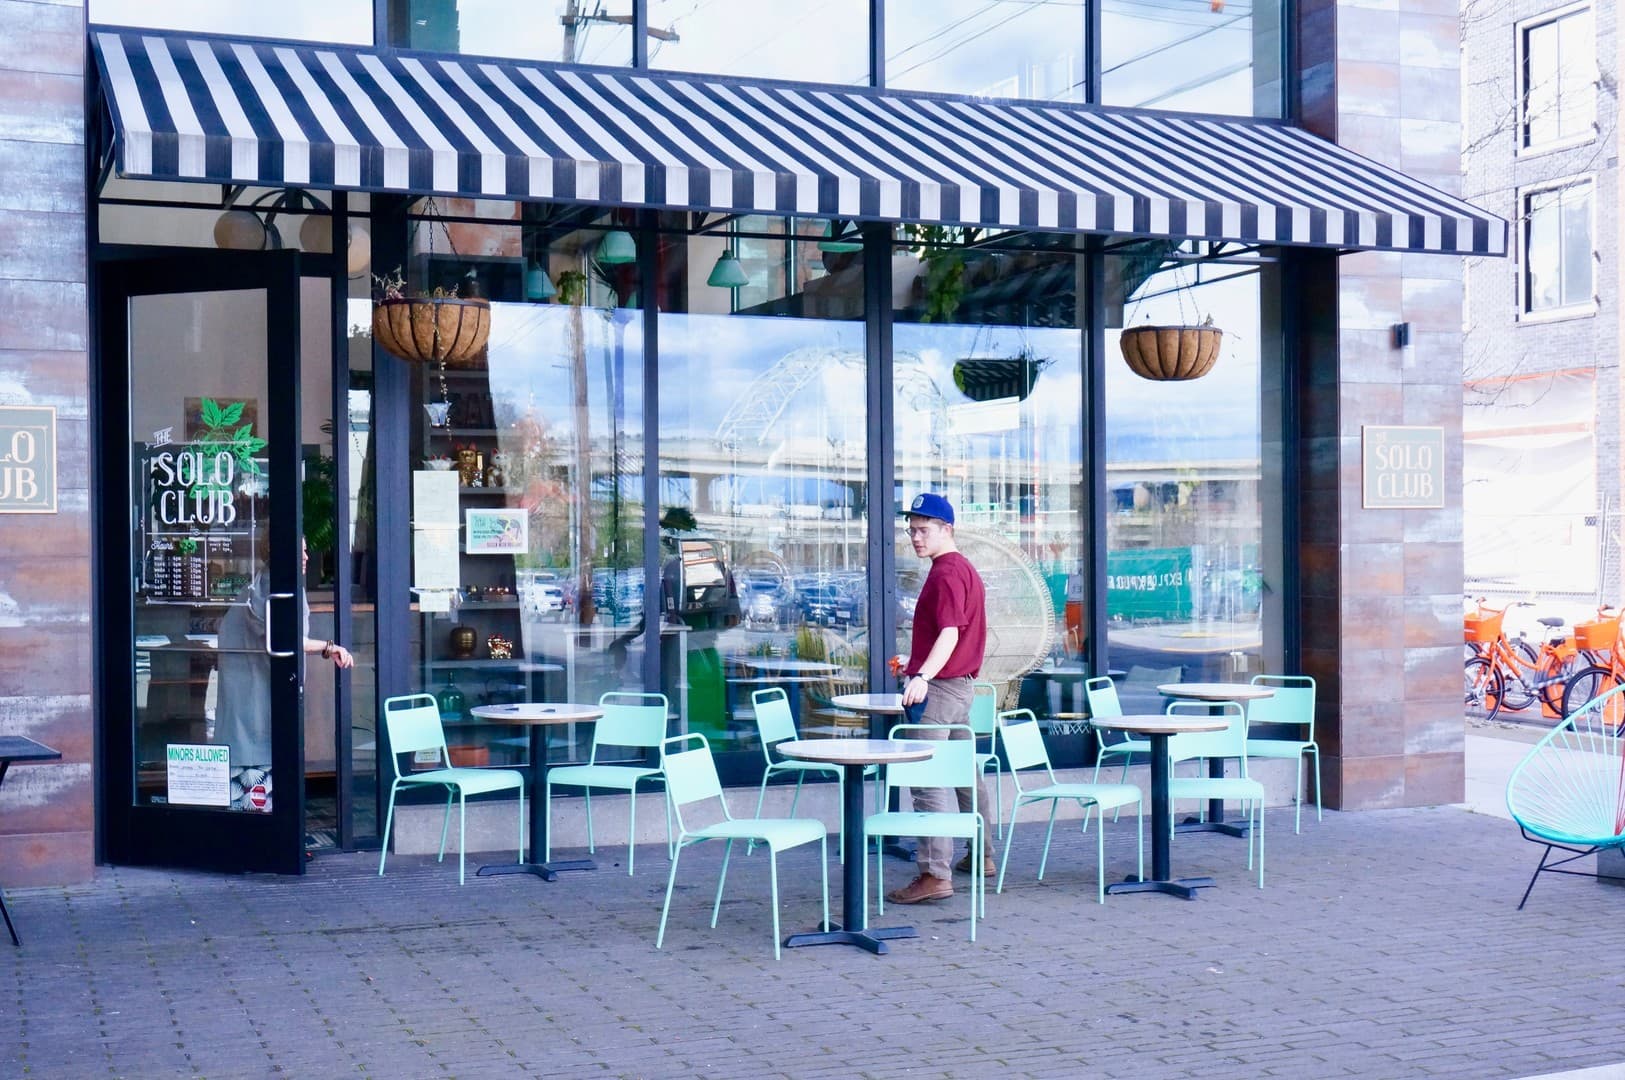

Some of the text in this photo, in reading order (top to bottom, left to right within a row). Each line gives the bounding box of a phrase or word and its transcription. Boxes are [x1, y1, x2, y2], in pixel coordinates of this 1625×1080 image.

[153, 426, 173, 448] THE
[158, 451, 234, 487] SOLO
[1375, 444, 1433, 471] SOLO
[1377, 472, 1433, 499] CLUB
[160, 490, 236, 527] CLUB
[168, 747, 228, 762] MINORS ALLOWED
